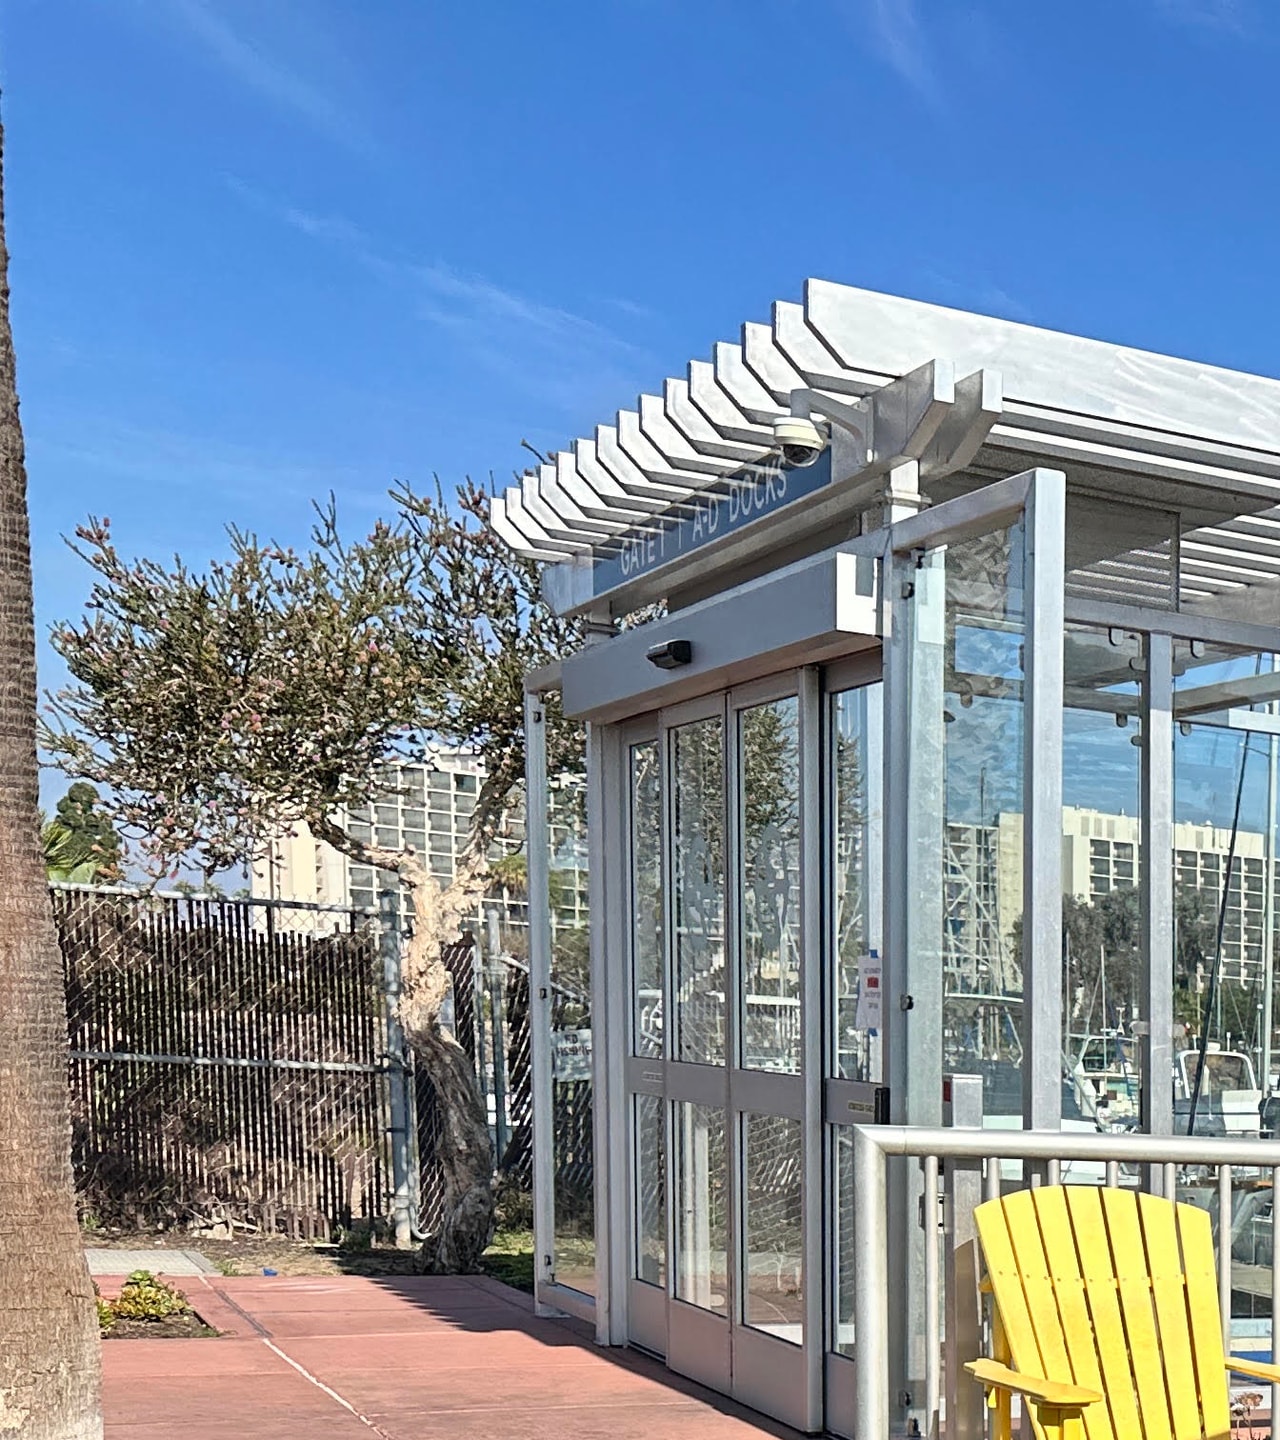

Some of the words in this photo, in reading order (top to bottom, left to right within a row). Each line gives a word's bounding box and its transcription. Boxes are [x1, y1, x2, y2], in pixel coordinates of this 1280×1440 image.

[620, 530, 655, 576] GATE
[692, 494, 719, 542] A-D
[729, 458, 787, 523] DOCKS
